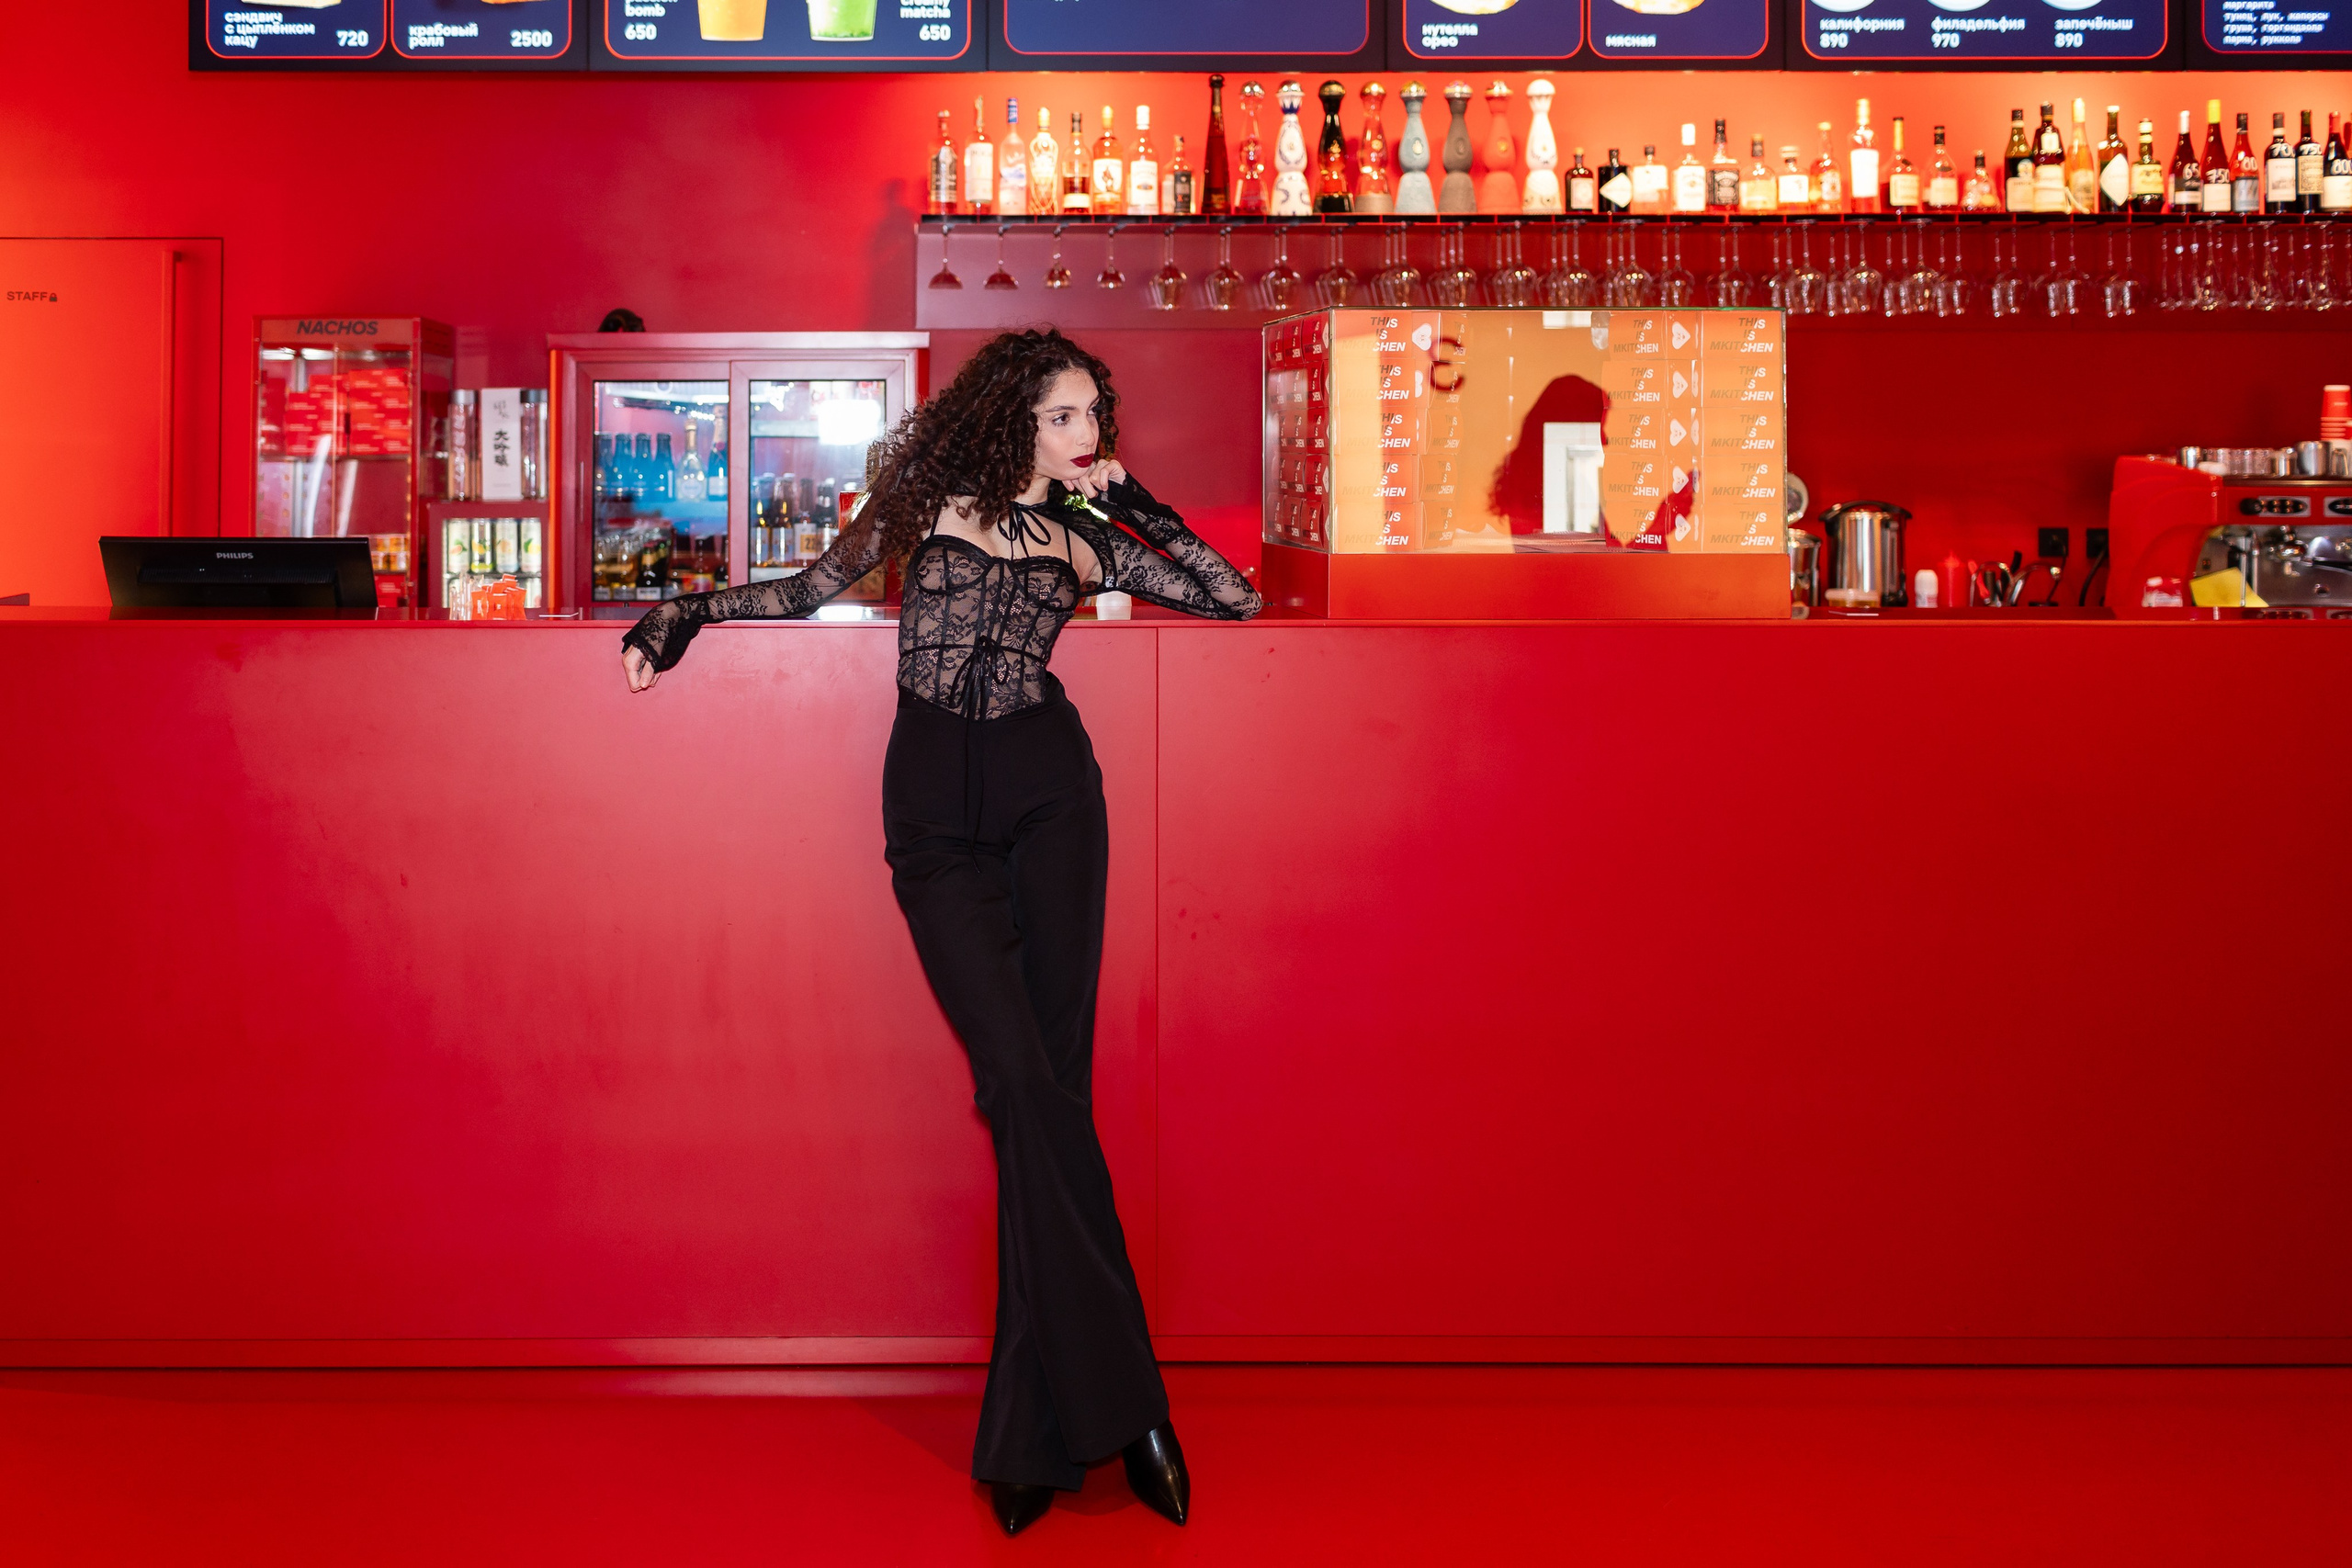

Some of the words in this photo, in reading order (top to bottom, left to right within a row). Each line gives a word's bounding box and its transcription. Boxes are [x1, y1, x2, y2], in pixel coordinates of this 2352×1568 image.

[625, 3, 666, 17] bomb
[899, 5, 951, 18] matcha
[224, 12, 283, 24] сэндвич
[1931, 16, 2026, 32] филадельфия
[2053, 16, 2134, 31] запечёныш
[224, 25, 234, 35] с
[236, 22, 315, 36] цыплёнком
[408, 23, 479, 38] крабовый
[1819, 17, 1905, 32] калифорния
[624, 22, 658, 40] 650
[919, 23, 952, 41] 650
[1421, 24, 1478, 38] нутелла
[224, 35, 258, 49] кацу
[336, 30, 368, 47] 720
[408, 36, 445, 49] ролл
[510, 30, 552, 48] 2500
[1605, 34, 1657, 48] мясная
[1819, 33, 1849, 48] 890
[1931, 33, 1961, 48] 970
[2053, 33, 2084, 48] 890
[6, 291, 48, 301] STAFF
[296, 320, 379, 336] NACHOS
[1370, 317, 1398, 328] THIS
[1634, 319, 1653, 330] THIS
[1738, 318, 1766, 329] THIS
[1613, 343, 1659, 354] MKITCHEN
[1710, 341, 1773, 353] MKITCHEN
[1379, 365, 1402, 377] HIS
[1631, 367, 1654, 378] THIS
[1738, 366, 1767, 378] THIS
[1608, 390, 1660, 402] MKITCHEN
[1710, 389, 1774, 401] MKITCHEN
[1380, 413, 1403, 424] HIS
[1628, 414, 1651, 425] THIS
[1739, 414, 1768, 426] THIS
[1606, 436, 1657, 449] MKITCHEN
[1711, 437, 1775, 449] MKITCHEN
[1631, 461, 1653, 473] THIS
[1740, 463, 1769, 475] THIS
[1608, 484, 1659, 497] MKITCHEN
[1712, 486, 1776, 498] MKITCHEN
[1634, 509, 1656, 521] THIS
[1739, 511, 1768, 523] THIS
[1710, 534, 1775, 546] MKITCHEN
